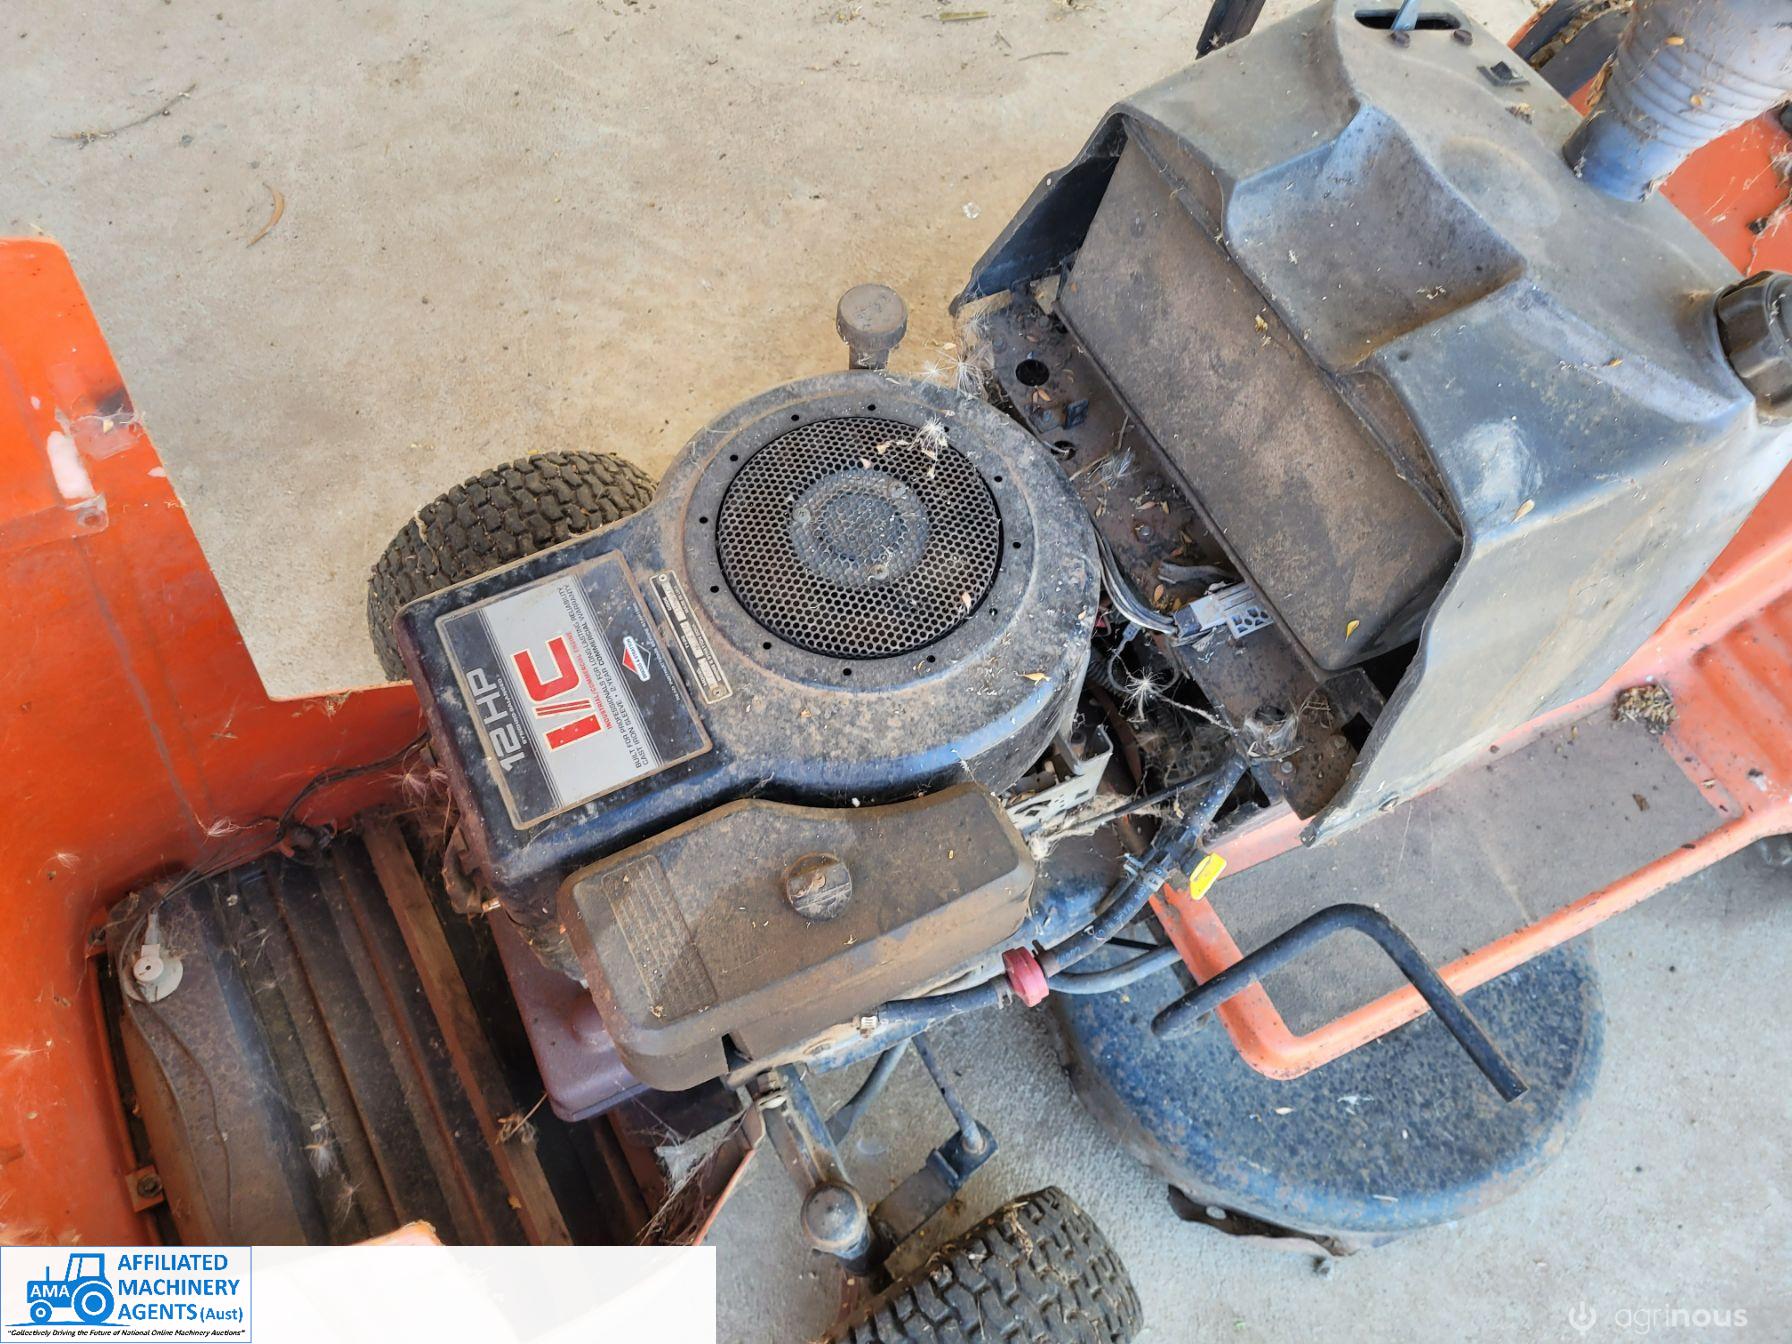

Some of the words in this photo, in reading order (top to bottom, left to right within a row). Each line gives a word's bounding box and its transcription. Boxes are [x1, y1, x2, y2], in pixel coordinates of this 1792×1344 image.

[556, 585, 578, 622] RELIABILITY
[563, 582, 586, 621] WARRANTY
[580, 621, 605, 666] COMMERCIAL
[591, 665, 603, 680] FOR
[466, 667, 507, 724] HP
[598, 679, 627, 734] PROFESSIONALS
[615, 699, 632, 726] SLEEVE
[489, 726, 526, 772] 12
[621, 732, 633, 748] FOR
[626, 725, 640, 745] IRON
[628, 748, 642, 769] BUILT
[635, 745, 649, 766] CAST
